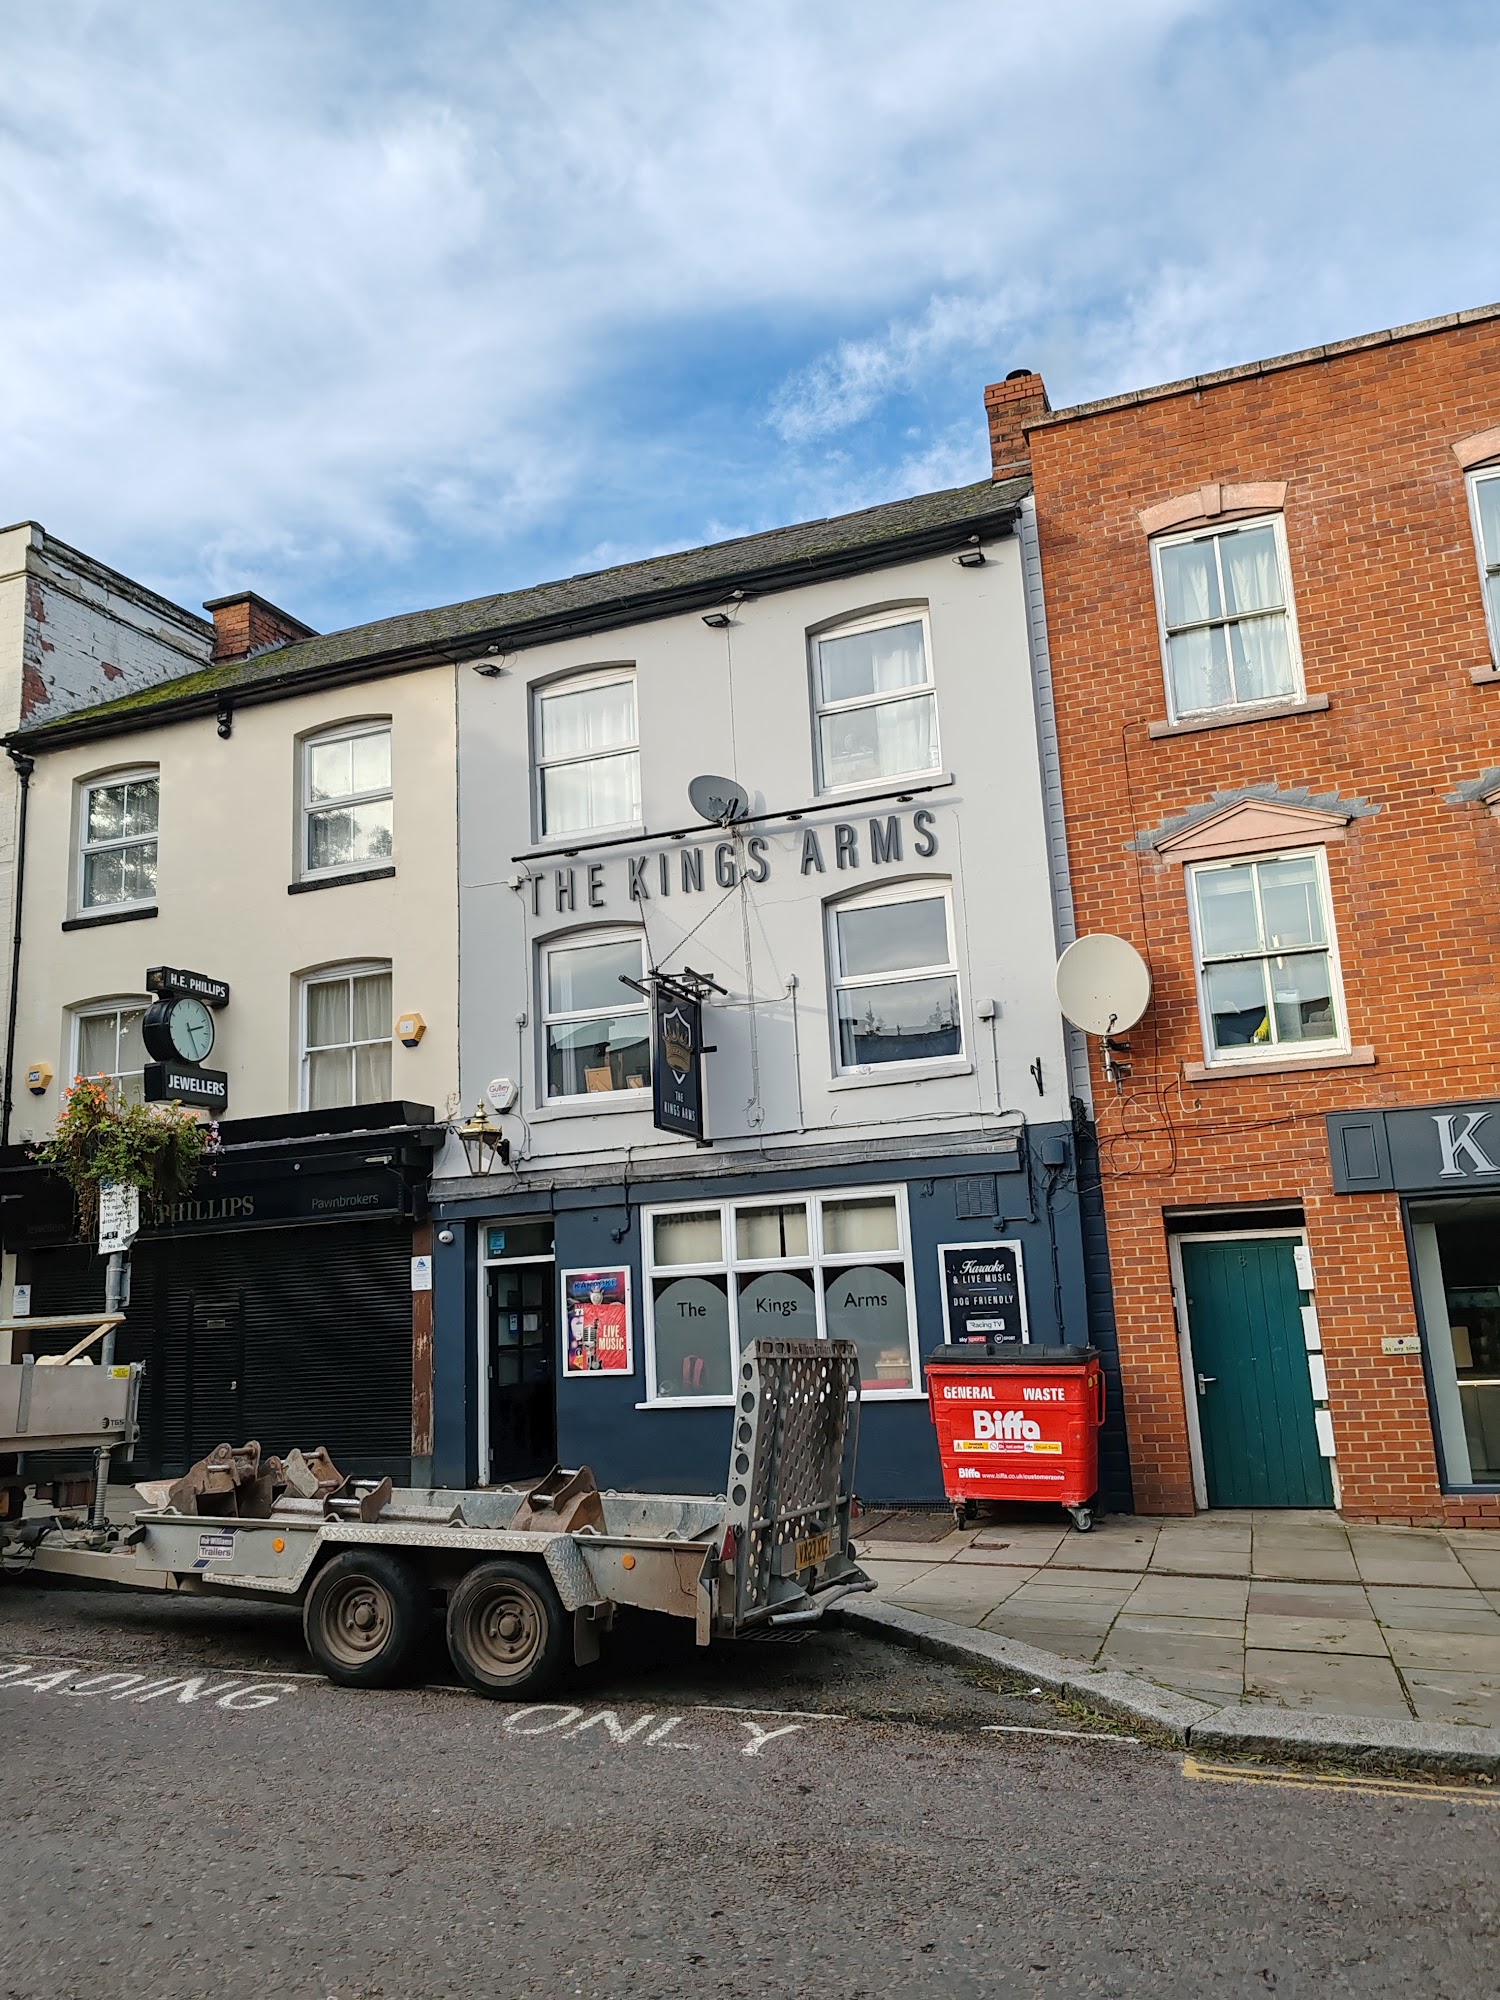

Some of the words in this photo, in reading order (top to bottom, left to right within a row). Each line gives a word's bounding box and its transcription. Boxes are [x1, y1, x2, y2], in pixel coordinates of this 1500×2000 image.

[526, 863, 604, 916] THE
[628, 837, 769, 901] KINGS
[801, 810, 937, 875] ARMS
[171, 973, 187, 988] H.E.
[190, 979, 225, 997] PHILLIPS
[168, 1075, 225, 1096] JEWELLERS
[489, 1085, 509, 1094] Gulley
[675, 1091, 684, 1103] THE
[664, 1101, 680, 1117] KINGS
[682, 1107, 696, 1122] ARMS
[156, 1196, 254, 1224] PHILLIPS
[311, 1194, 379, 1210] Pawnbrokers
[959, 1260, 1005, 1274] Karaoke
[953, 1276, 959, 1284] &
[963, 1275, 981, 1284] LIVE
[985, 1273, 1012, 1283] MUSIC
[677, 1303, 706, 1317] The
[756, 1298, 798, 1317] Kings
[844, 1292, 888, 1307] Arms
[954, 1297, 970, 1306] DOG
[974, 1295, 1013, 1305] FRIENDLY
[603, 1325, 620, 1337] LIVE
[599, 1337, 624, 1350] MUSIC
[943, 1386, 995, 1399] GENERAL
[1023, 1387, 1065, 1401] WASTE
[973, 1410, 1041, 1440] Biffa
[958, 1468, 981, 1479] Biffa
[982, 1473, 1065, 1481] www.biffa.co.uk/customerzone
[201, 1548, 231, 1556] Trailers
[502, 1704, 806, 1756] ONLY
